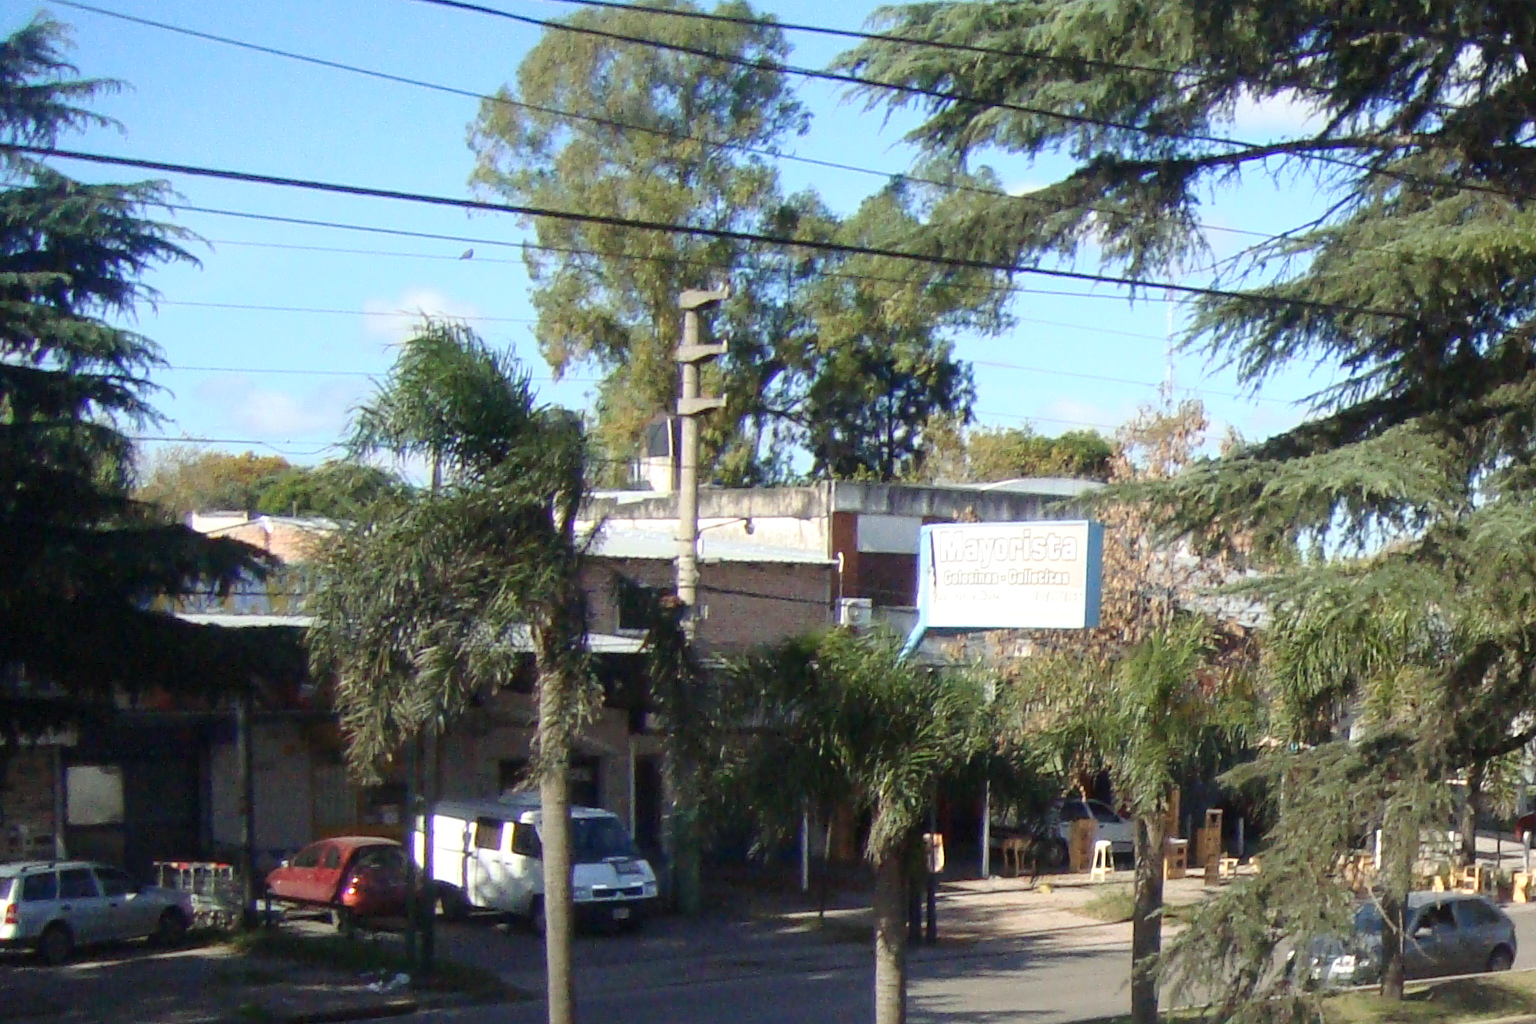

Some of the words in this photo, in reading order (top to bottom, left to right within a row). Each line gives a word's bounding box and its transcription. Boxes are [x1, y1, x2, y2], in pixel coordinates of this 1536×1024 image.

[940, 529, 1077, 568] Mayorista
[944, 570, 999, 586] Golosinas
[1008, 569, 1070, 586] Galletitas
